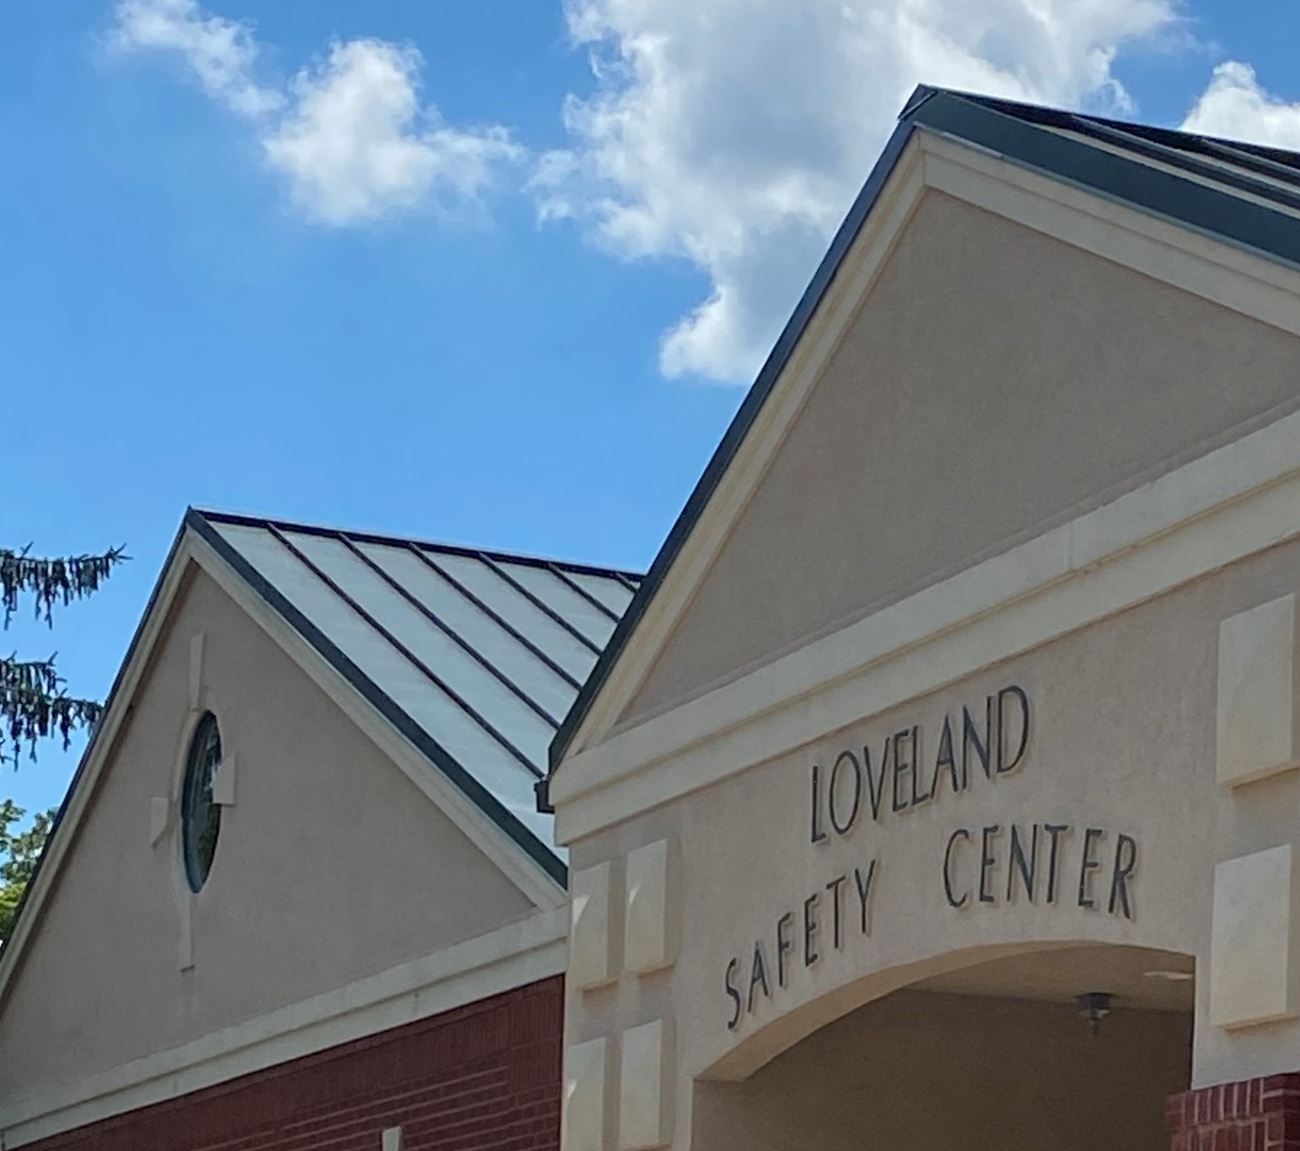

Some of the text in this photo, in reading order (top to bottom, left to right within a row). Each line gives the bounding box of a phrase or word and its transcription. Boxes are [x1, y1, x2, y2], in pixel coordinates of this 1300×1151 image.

[811, 685, 1030, 843] LOVELAND
[725, 823, 1138, 1030] SAFETY CENTER
